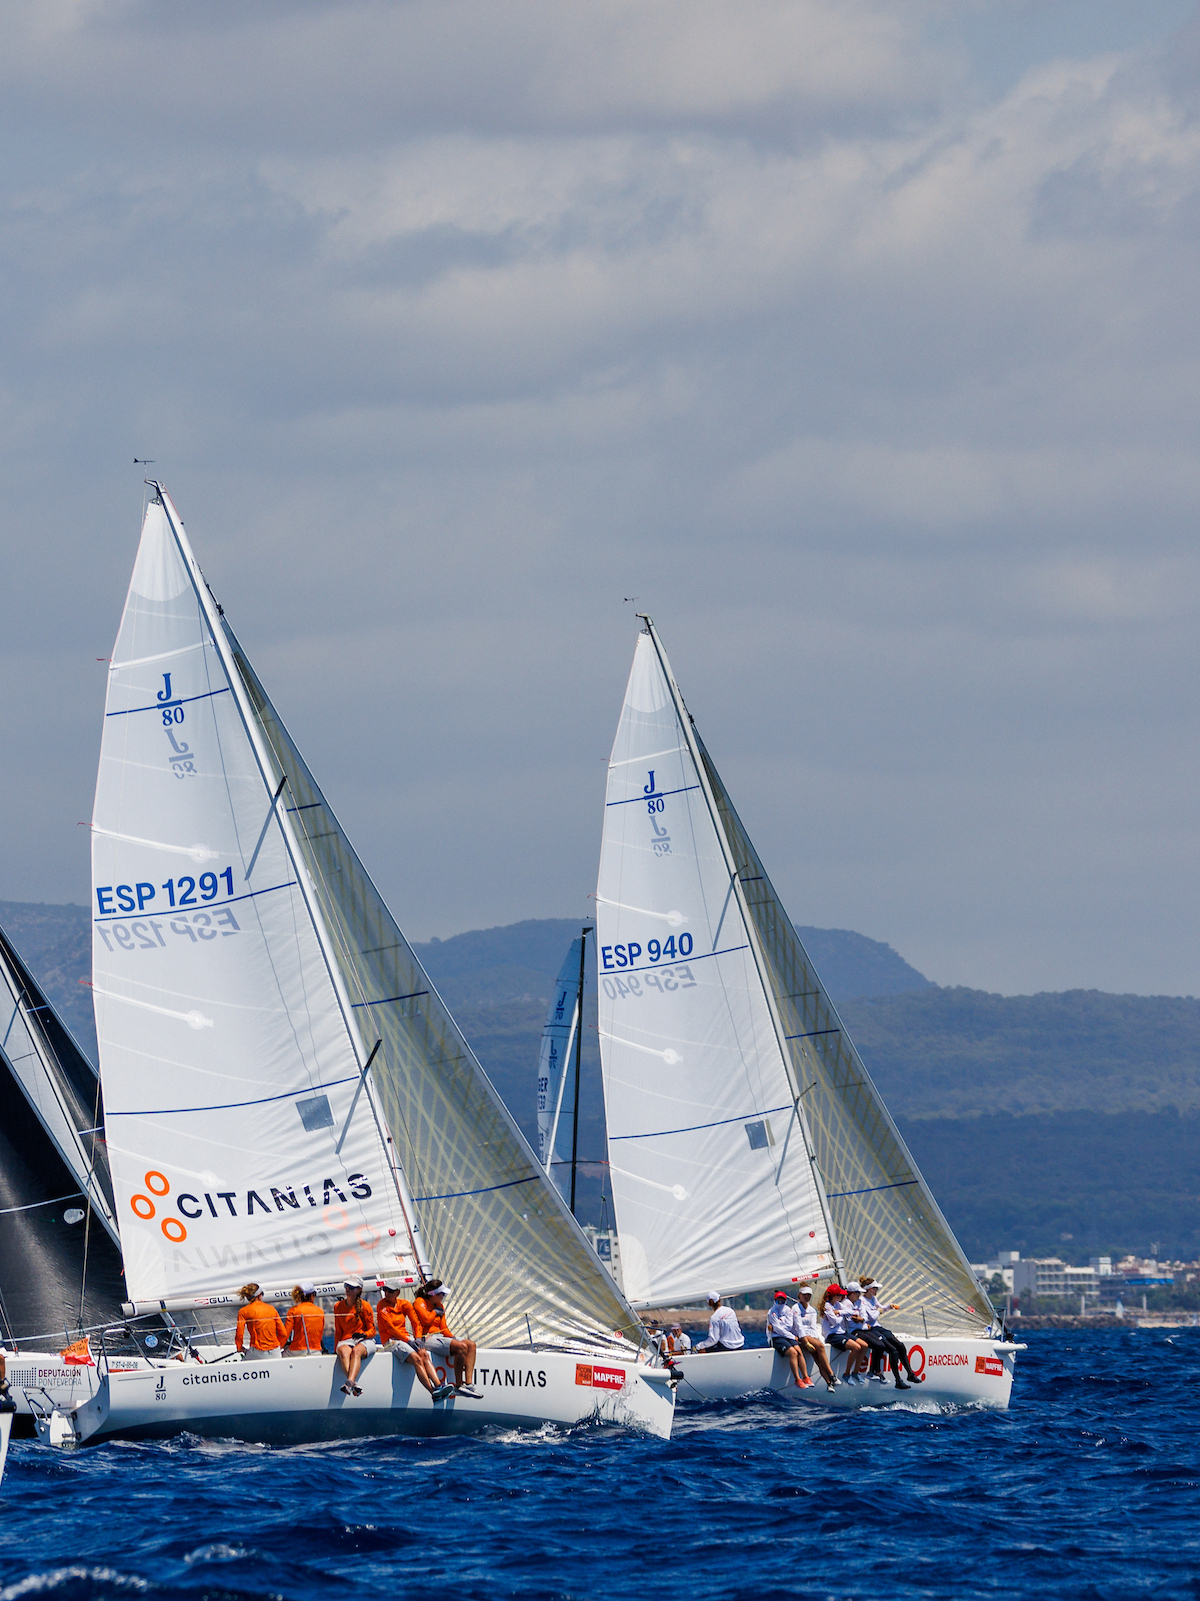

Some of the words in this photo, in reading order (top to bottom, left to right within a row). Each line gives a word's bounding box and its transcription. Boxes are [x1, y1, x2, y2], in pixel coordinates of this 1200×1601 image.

[157, 673, 172, 701] J
[162, 707, 185, 726] 80
[644, 770, 655, 794] J
[647, 798, 665, 814] 80
[96, 882, 156, 914] ESP
[162, 866, 235, 907] 1291
[601, 942, 642, 969] ESP
[647, 932, 694, 962] 940
[176, 1173, 373, 1219] CITANIAS
[210, 1296, 233, 1304] GUL
[928, 1355, 968, 1366] BARCELONA
[156, 1376, 165, 1389] J
[182, 1370, 270, 1385] citanias.com
[461, 1368, 547, 1387] ITANIAS
[594, 1372, 624, 1385] MAPFRE
